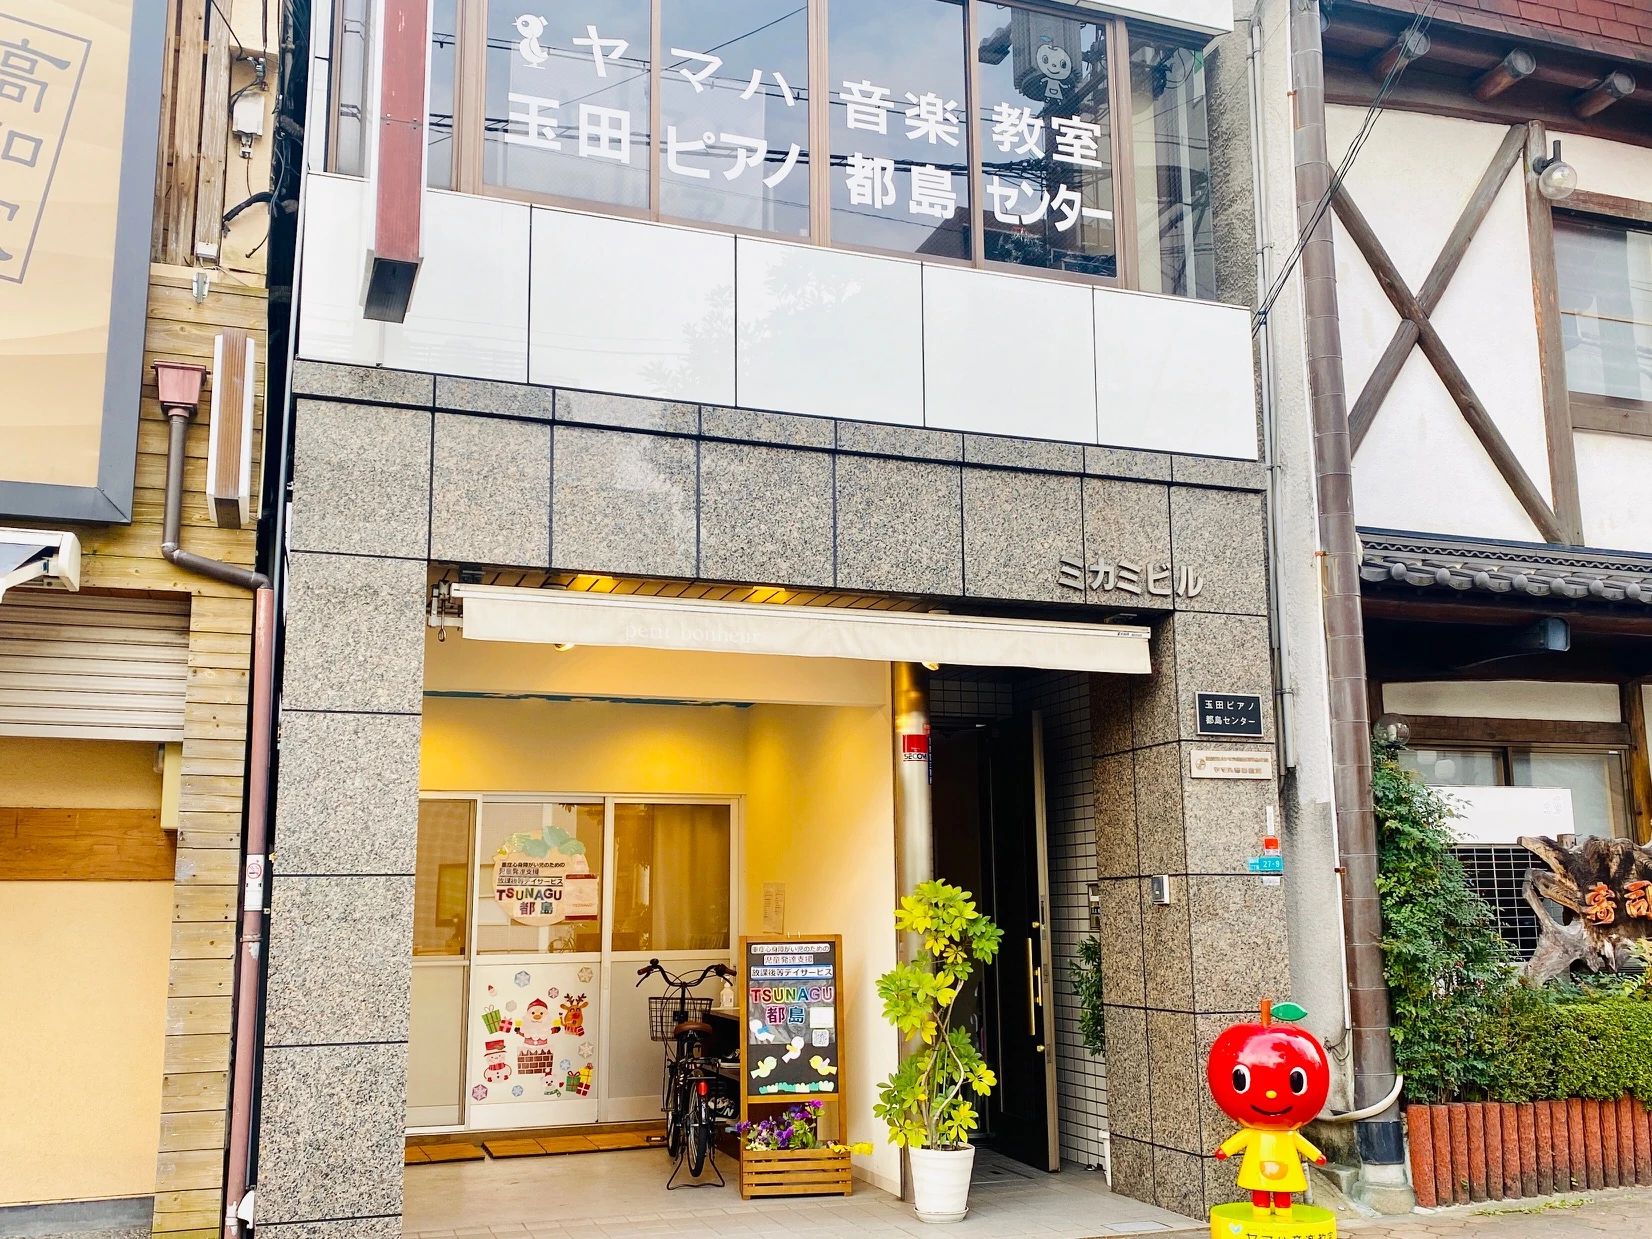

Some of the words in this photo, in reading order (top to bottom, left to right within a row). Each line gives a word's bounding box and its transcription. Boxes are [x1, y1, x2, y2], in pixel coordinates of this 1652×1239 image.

[1057, 556, 1203, 598] ミカミビル
[1204, 699, 1254, 711] 玉田ピアノ
[1205, 715, 1256, 726] 都島センター
[496, 887, 562, 901] TSUNAGU
[519, 901, 554, 915] 都島
[750, 987, 833, 1002] TSUNAGU
[766, 1006, 805, 1024] 都島
